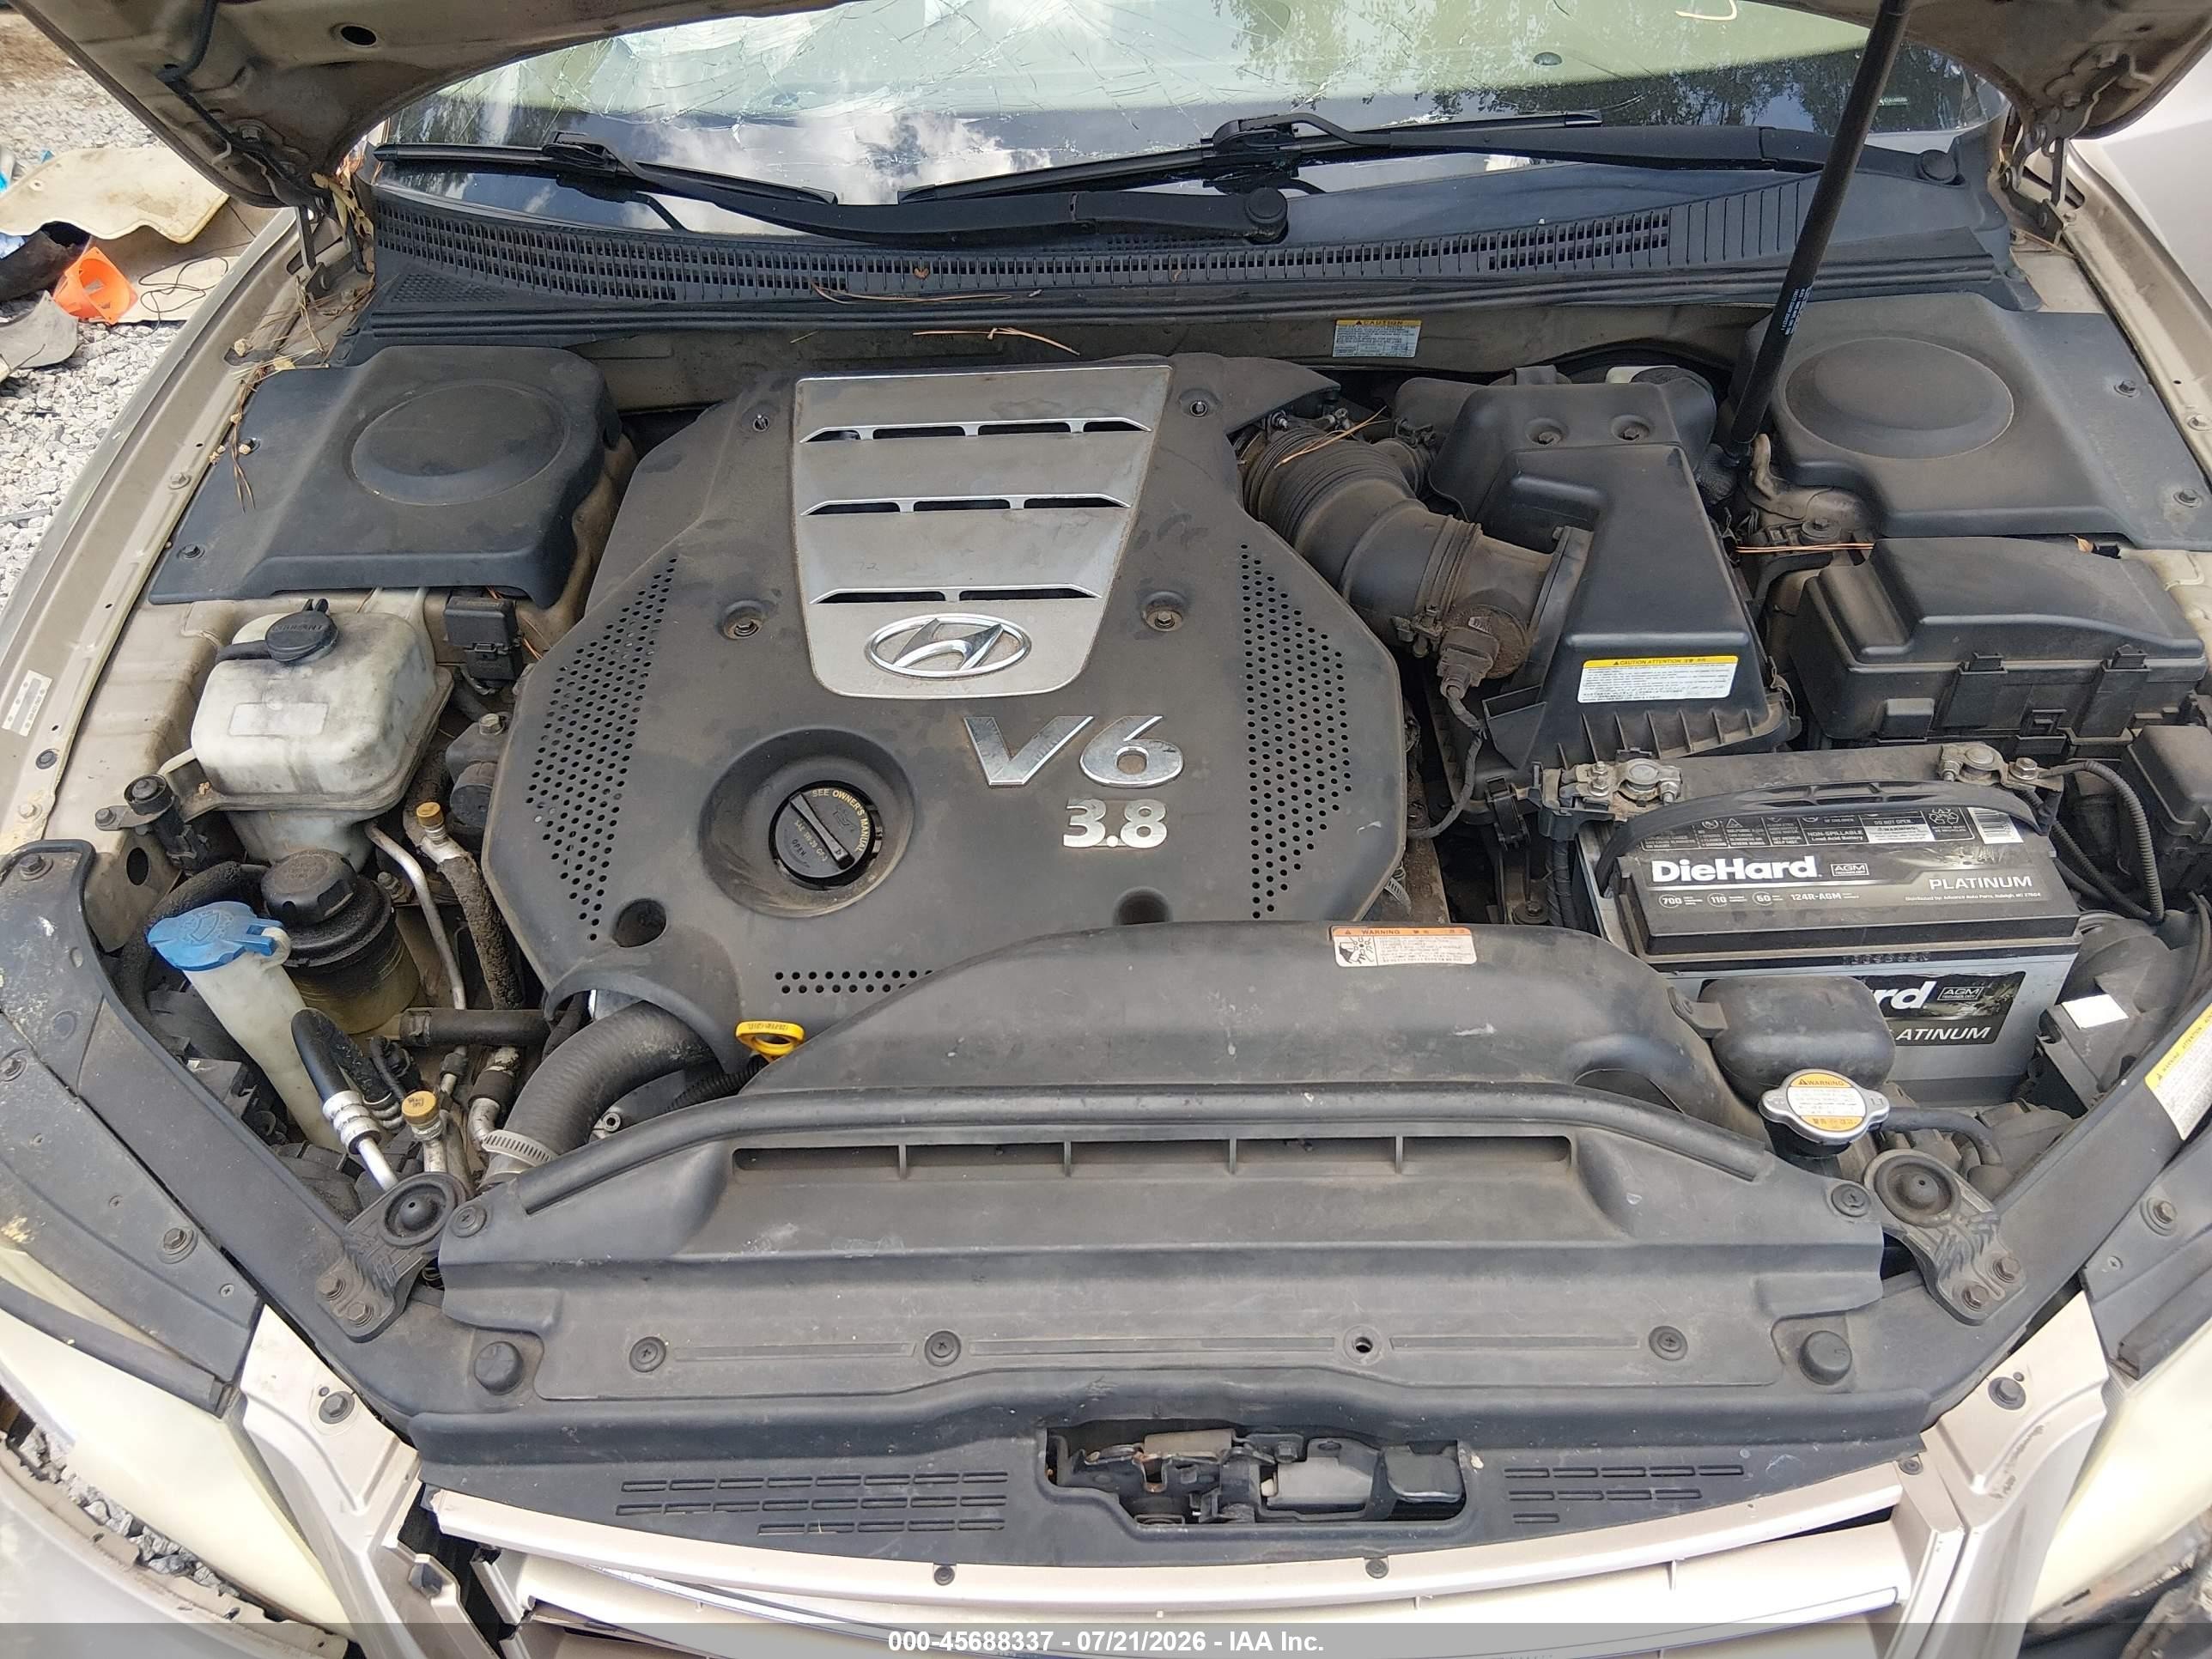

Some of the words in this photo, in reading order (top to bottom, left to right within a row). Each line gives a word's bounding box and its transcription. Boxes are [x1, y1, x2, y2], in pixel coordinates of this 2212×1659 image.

[963, 715, 1184, 788] V6
[812, 789, 830, 797] SEE
[832, 789, 865, 816] OWNER'S
[854, 818, 870, 852] MANUAL
[1063, 799, 1168, 848] 3.8
[792, 839, 807, 857] OPEN
[1651, 855, 1818, 883] DieHard
[1929, 876, 2033, 890] PLATINUM
[1790, 893, 1842, 901] 124R-AGM
[1896, 1027, 1991, 1041] ATINUM
